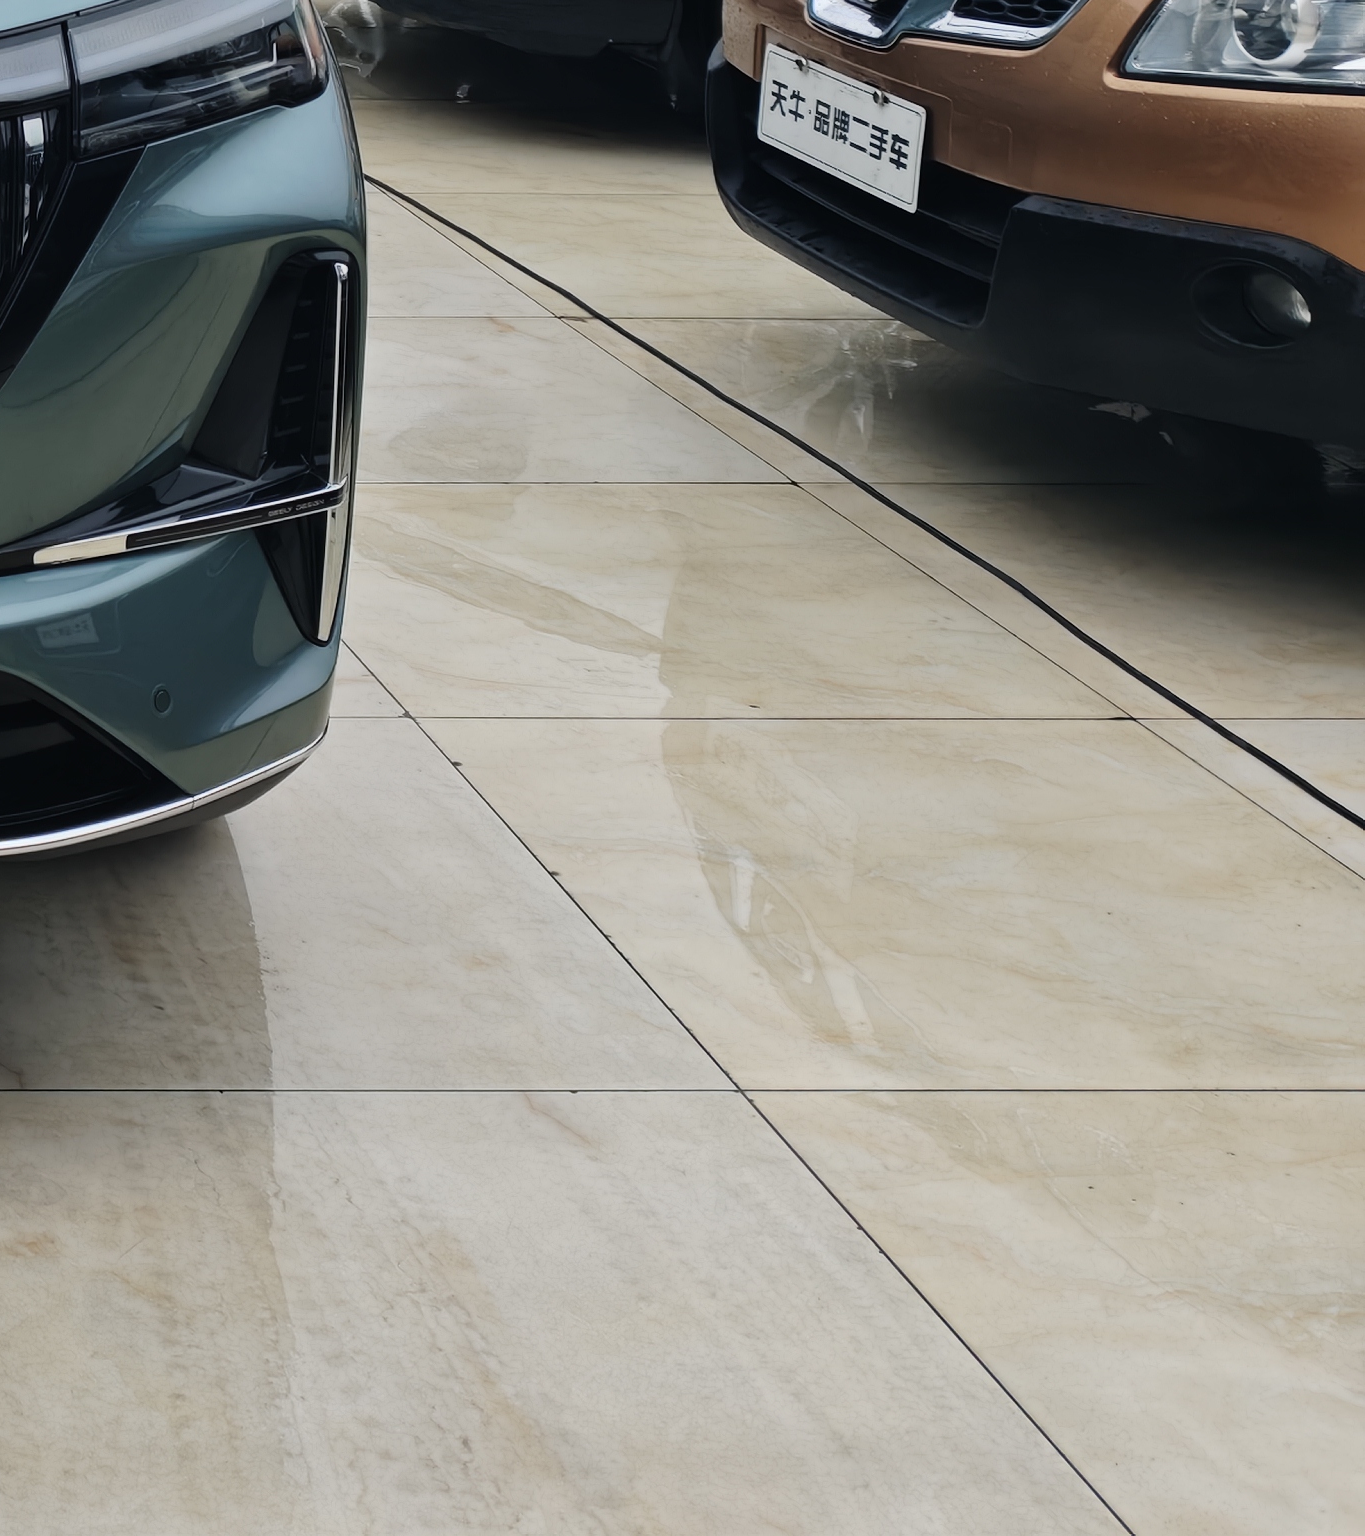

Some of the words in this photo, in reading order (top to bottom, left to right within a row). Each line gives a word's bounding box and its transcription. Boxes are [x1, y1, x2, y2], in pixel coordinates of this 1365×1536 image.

[769, 79, 910, 171] 天牛·品牌二手车
